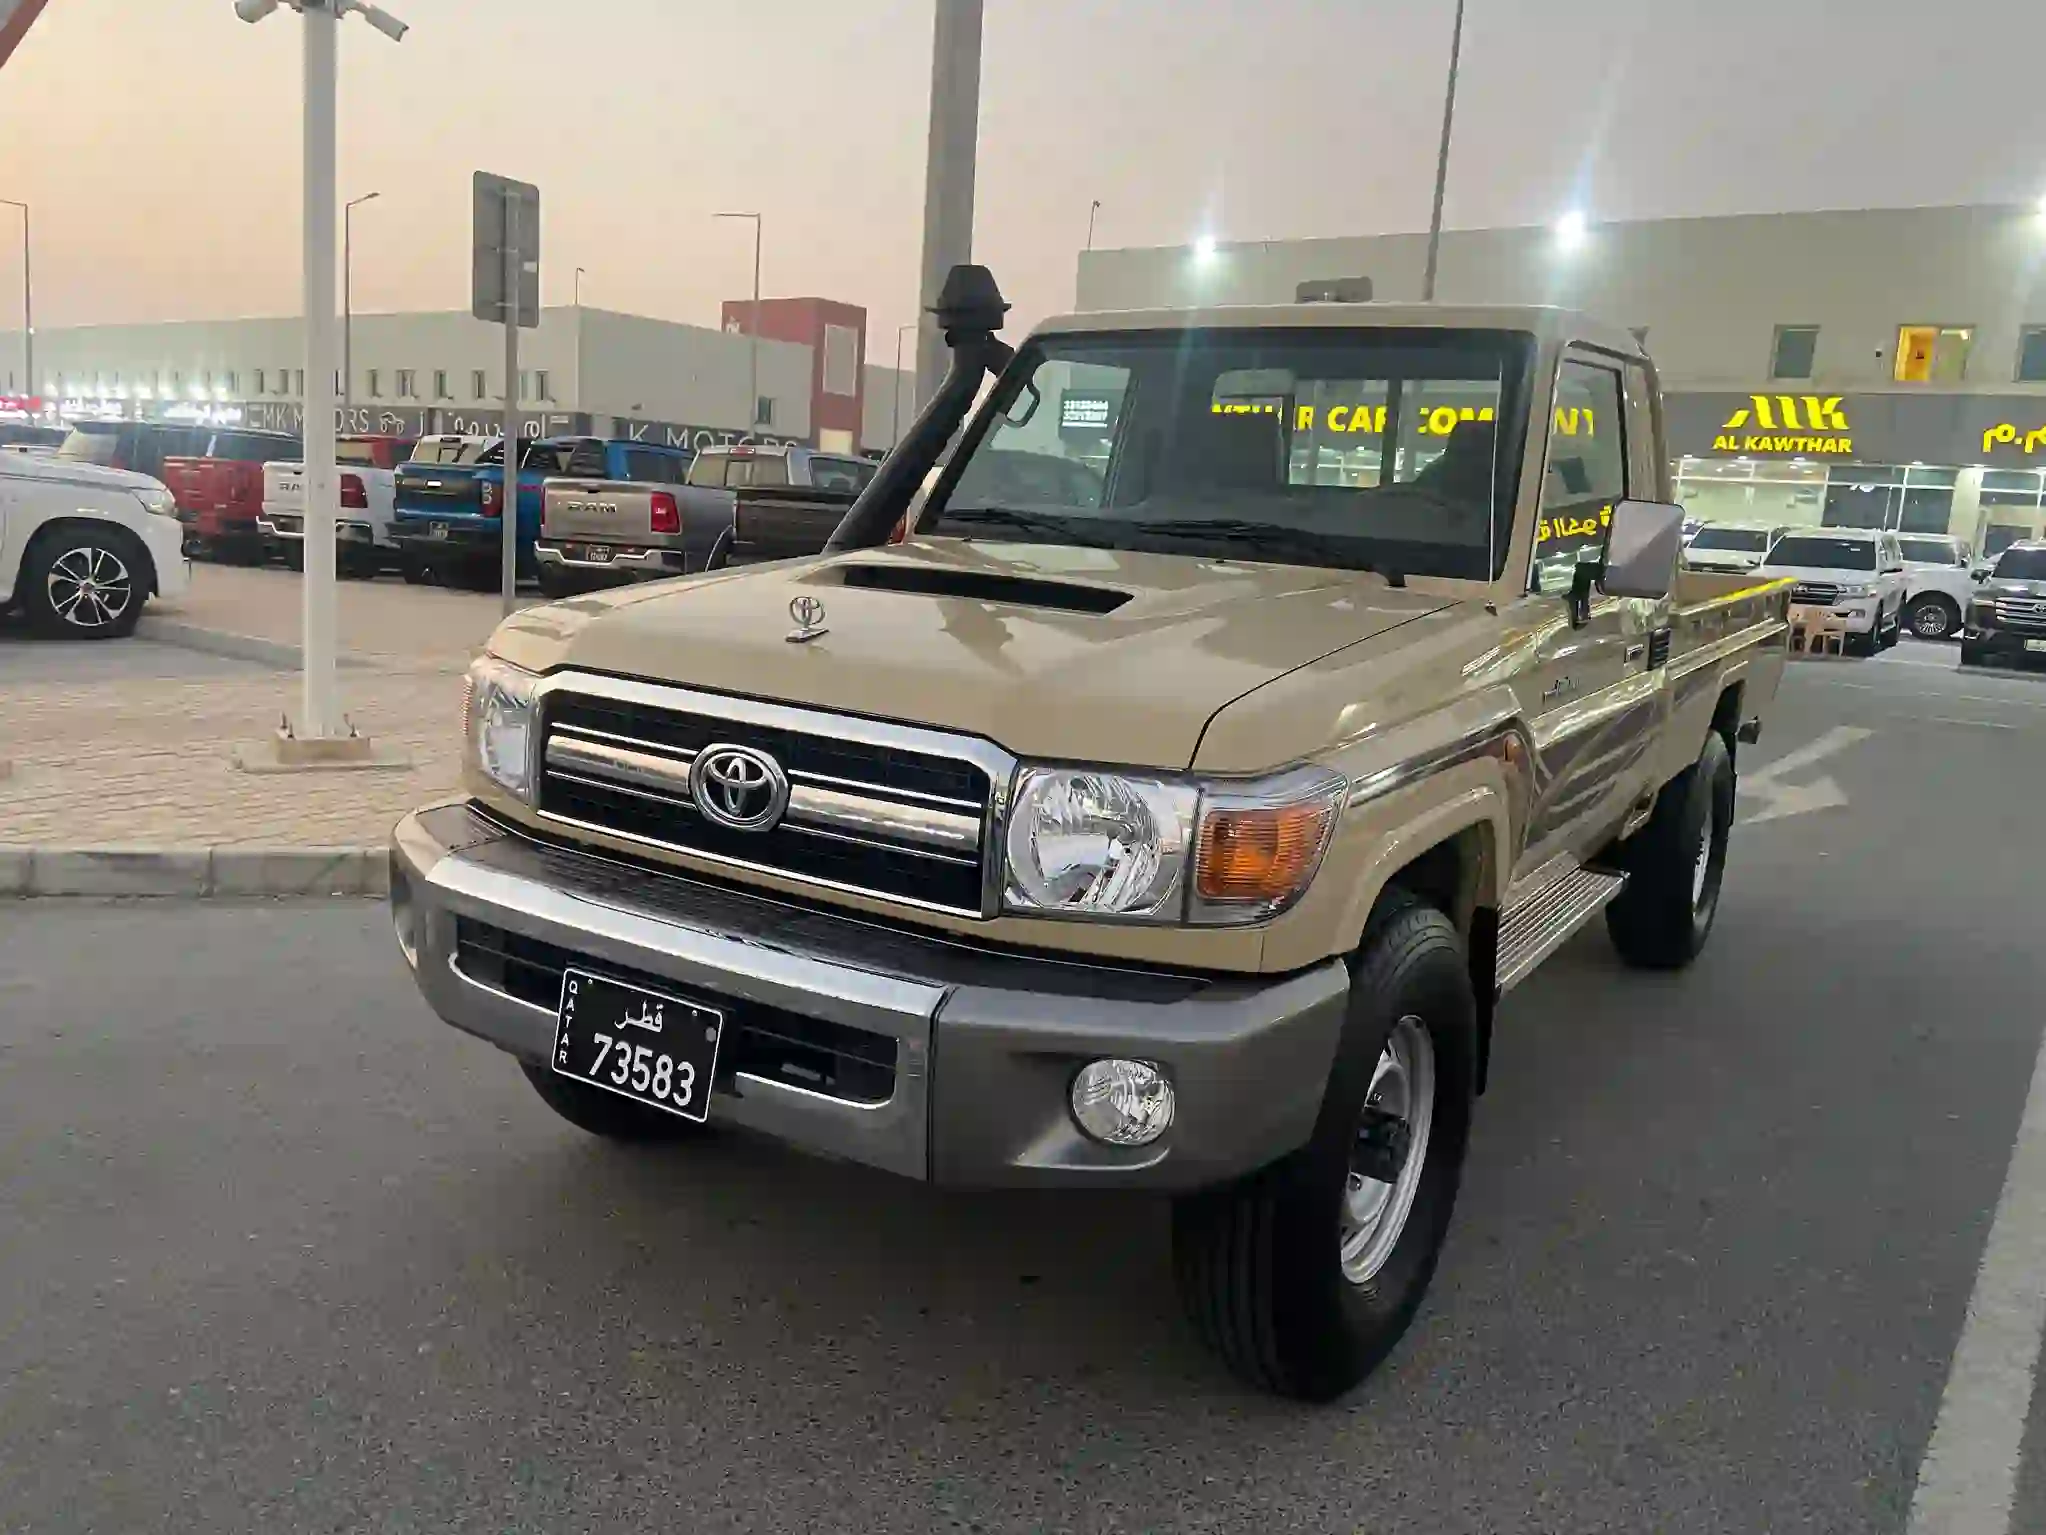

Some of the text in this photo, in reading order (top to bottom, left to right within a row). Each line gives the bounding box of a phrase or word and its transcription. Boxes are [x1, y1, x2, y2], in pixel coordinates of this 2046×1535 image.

[1712, 435, 1853, 453] AL KAWTHAR
[567, 501, 617, 513] RAM
[558, 980, 579, 1064] QATAR
[613, 999, 665, 1033] قطر
[588, 1032, 695, 1107] 73583
